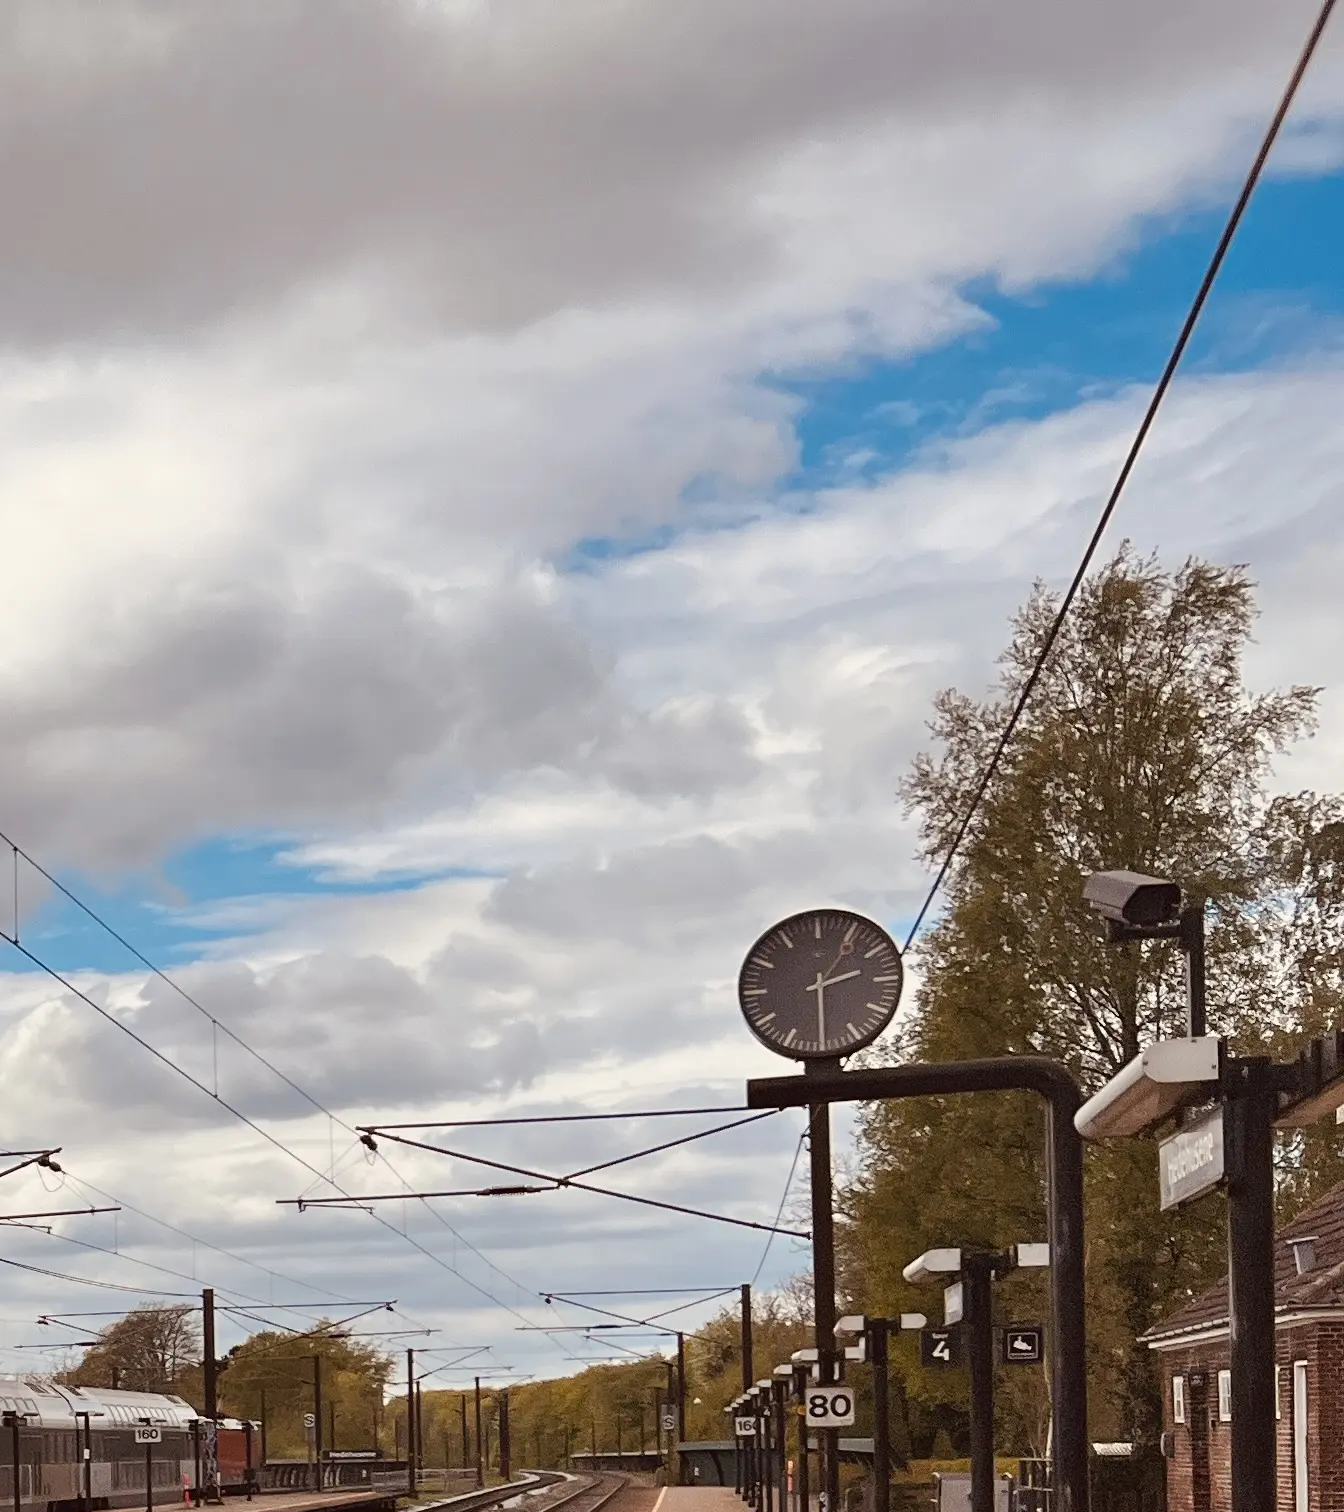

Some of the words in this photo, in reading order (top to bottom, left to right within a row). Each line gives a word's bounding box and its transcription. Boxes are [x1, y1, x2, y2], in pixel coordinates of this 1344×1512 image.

[931, 1340, 950, 1361] 4
[809, 1394, 851, 1418] 80
[137, 1428, 159, 1440] 160
